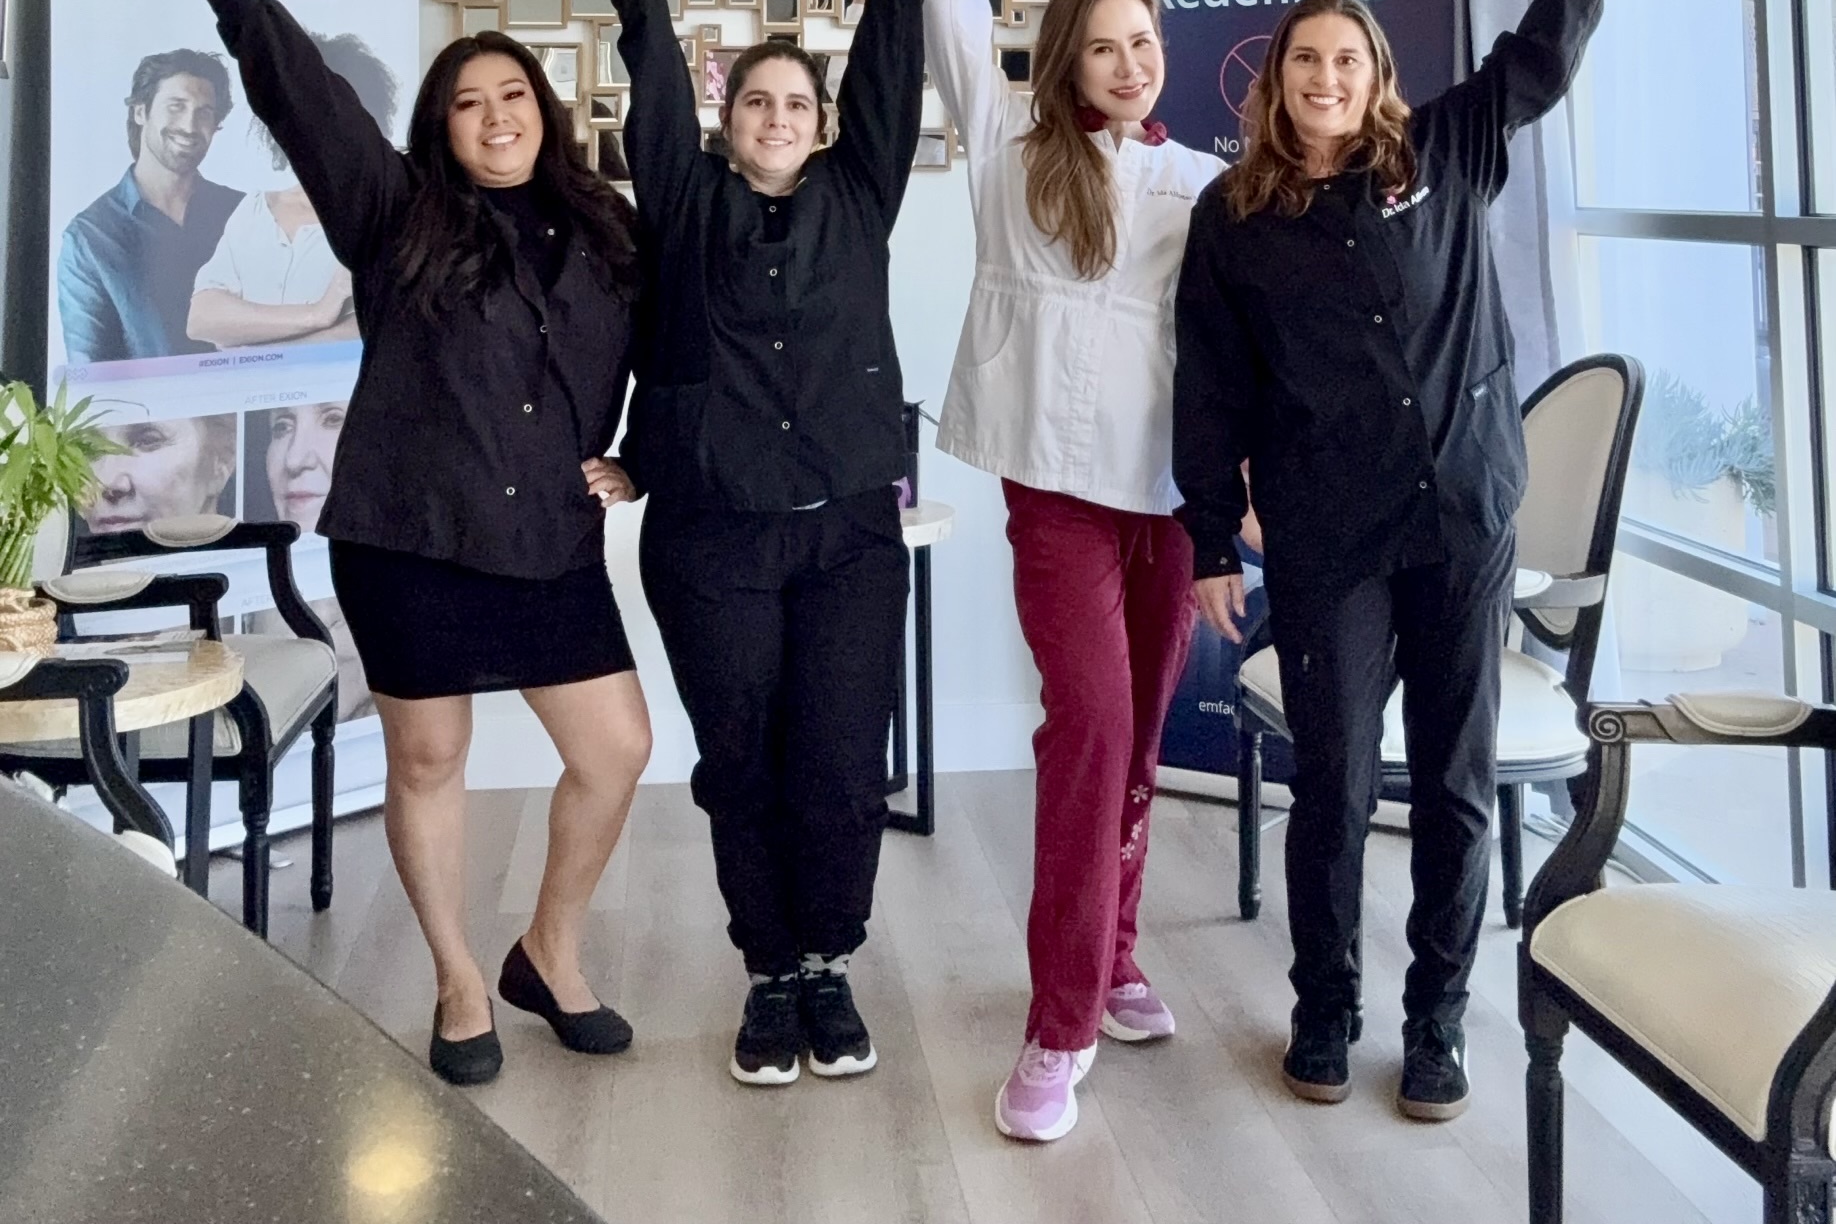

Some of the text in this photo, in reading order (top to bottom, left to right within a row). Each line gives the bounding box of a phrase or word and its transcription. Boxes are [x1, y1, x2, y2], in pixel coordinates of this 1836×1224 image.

[1214, 136, 1240, 163] No
[244, 390, 308, 405] AFTER EXION
